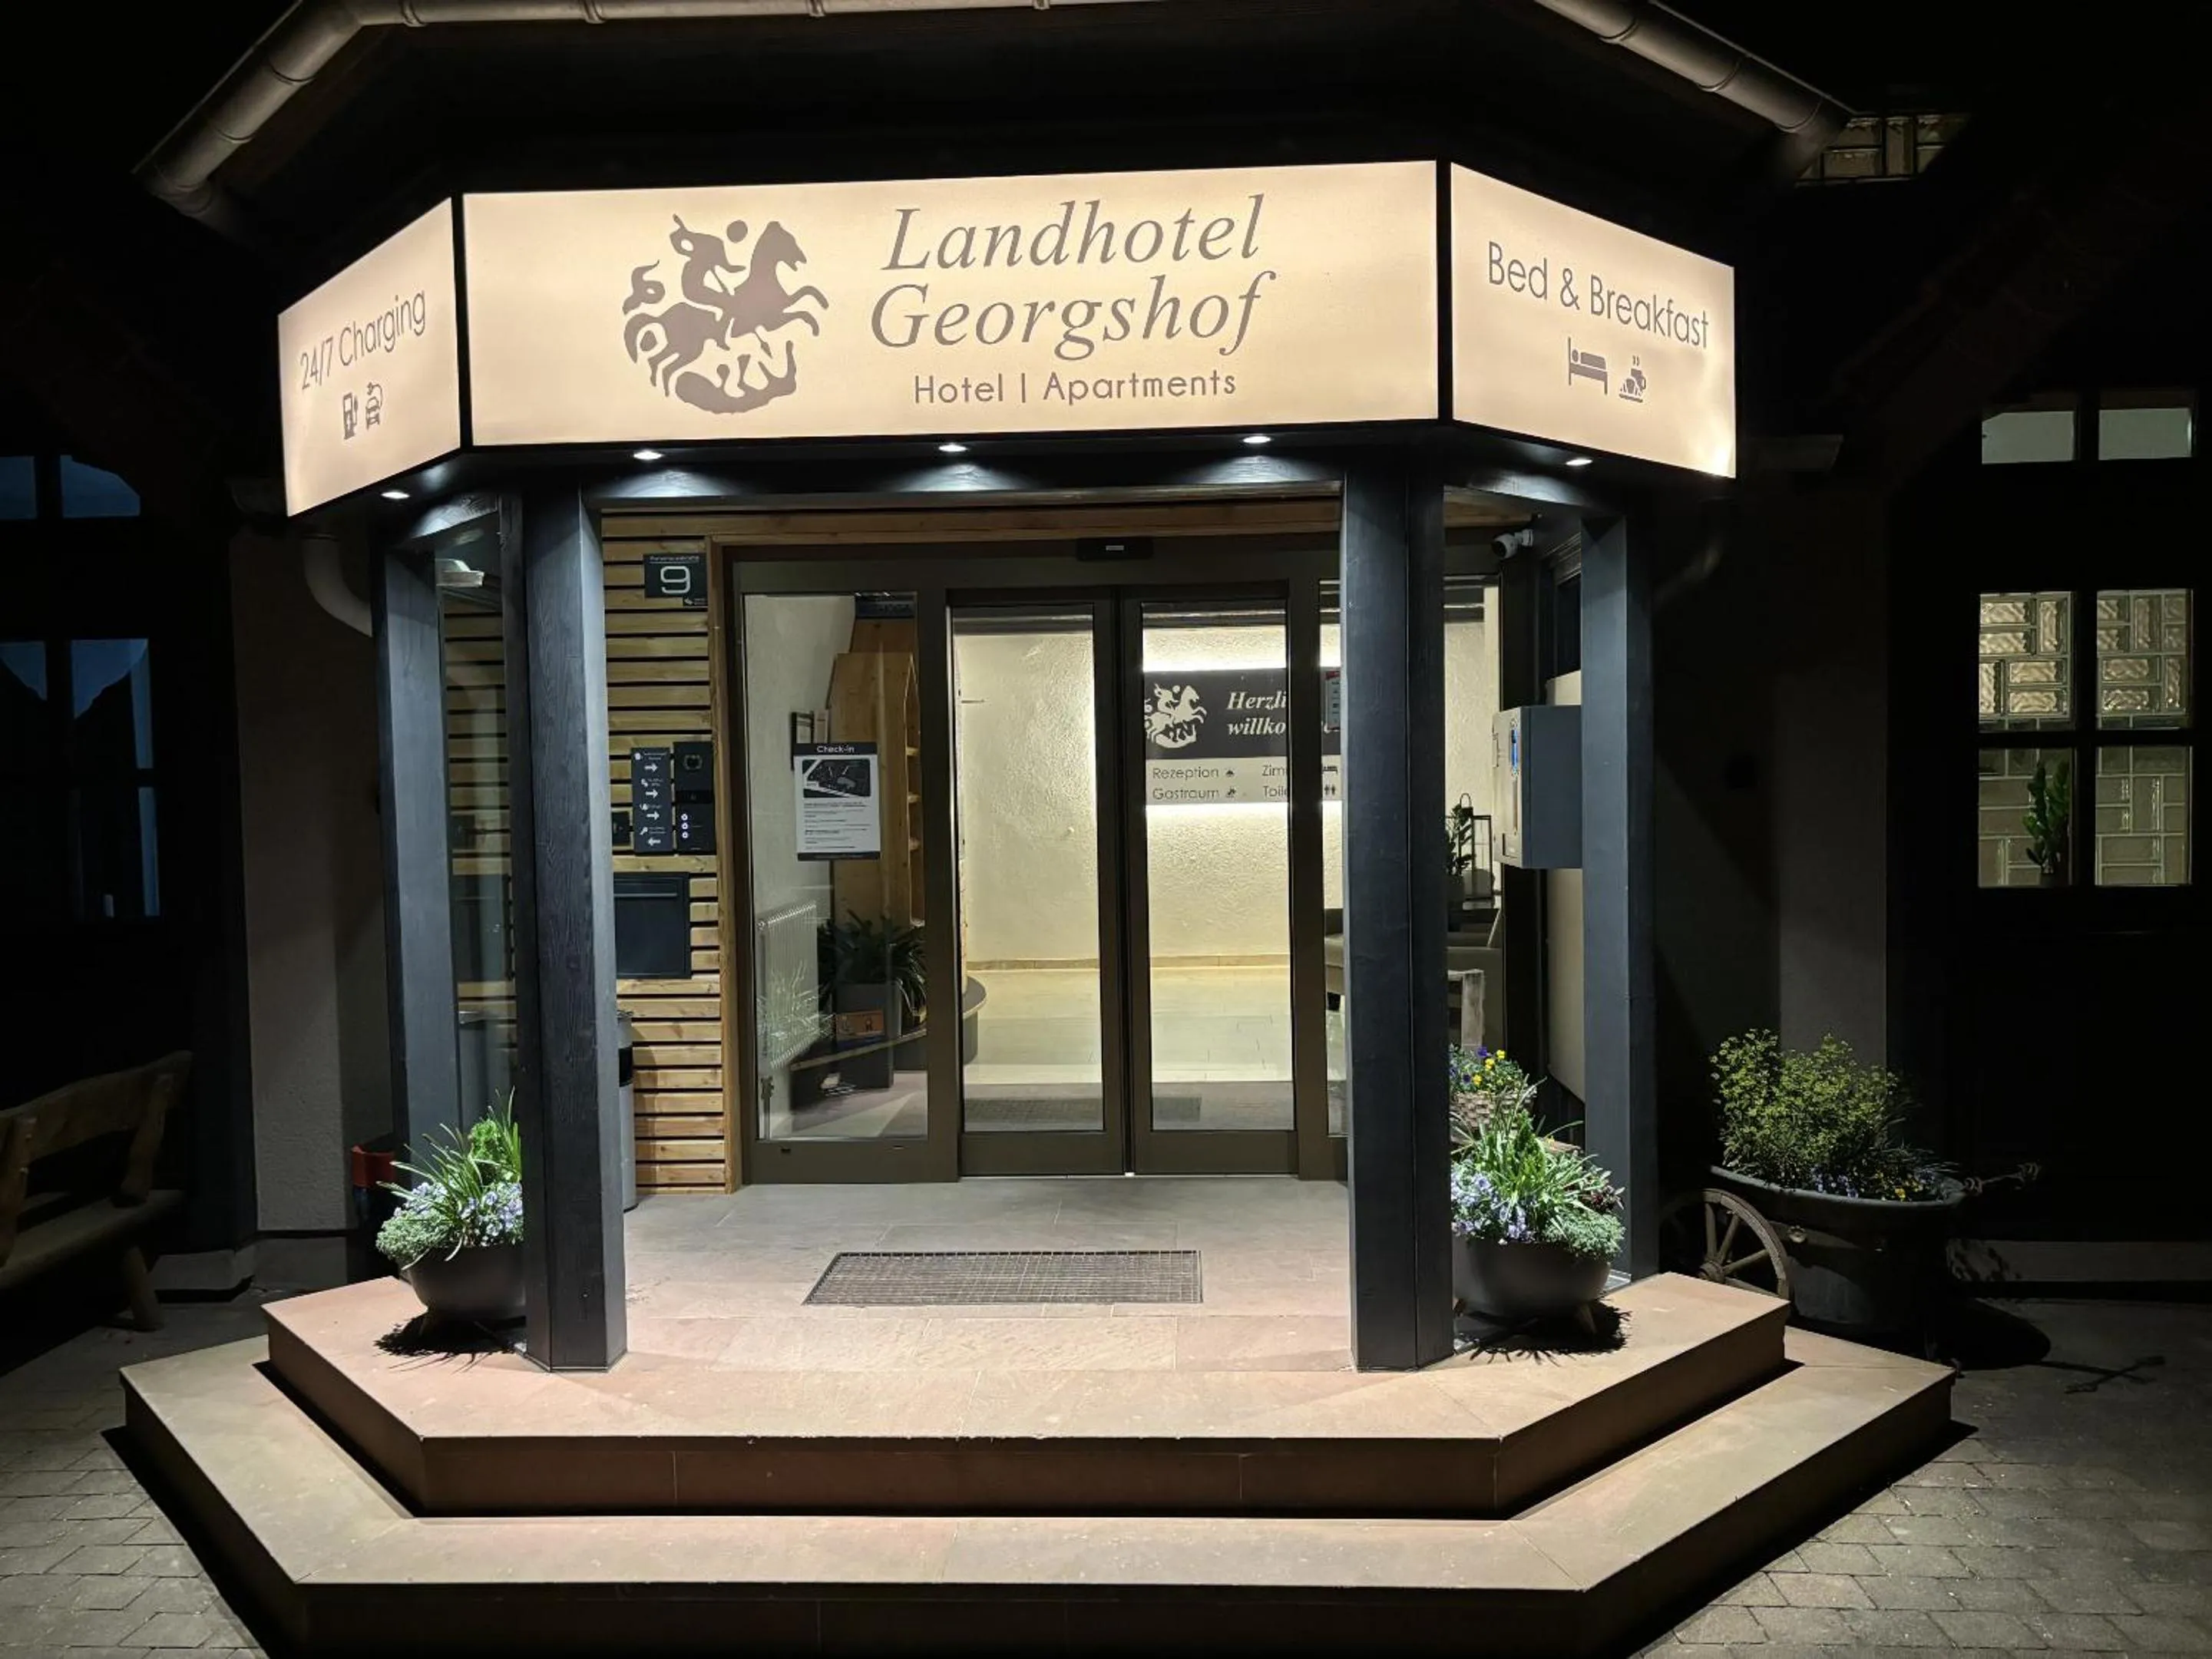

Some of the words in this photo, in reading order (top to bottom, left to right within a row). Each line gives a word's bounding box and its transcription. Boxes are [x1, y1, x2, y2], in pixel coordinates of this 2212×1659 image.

[879, 193, 1265, 271] Landhotel
[1489, 240, 1548, 300] Bed
[1559, 268, 1581, 310] &
[1590, 274, 1709, 349] Breakfast
[871, 271, 1276, 361] Georgshof
[300, 336, 334, 390] 24/7
[339, 289, 426, 367] Charging
[914, 373, 1004, 405] Hotel
[1043, 368, 1237, 406] Apartments
[660, 565, 691, 594] 9
[1225, 690, 1287, 711] Herzli
[1226, 716, 1287, 735] willko
[816, 745, 855, 754] Check-in
[1152, 766, 1219, 781] Rezeption
[1262, 765, 1286, 777] Zim
[1152, 788, 1220, 800] Gastraum
[1263, 785, 1288, 798] Toil
